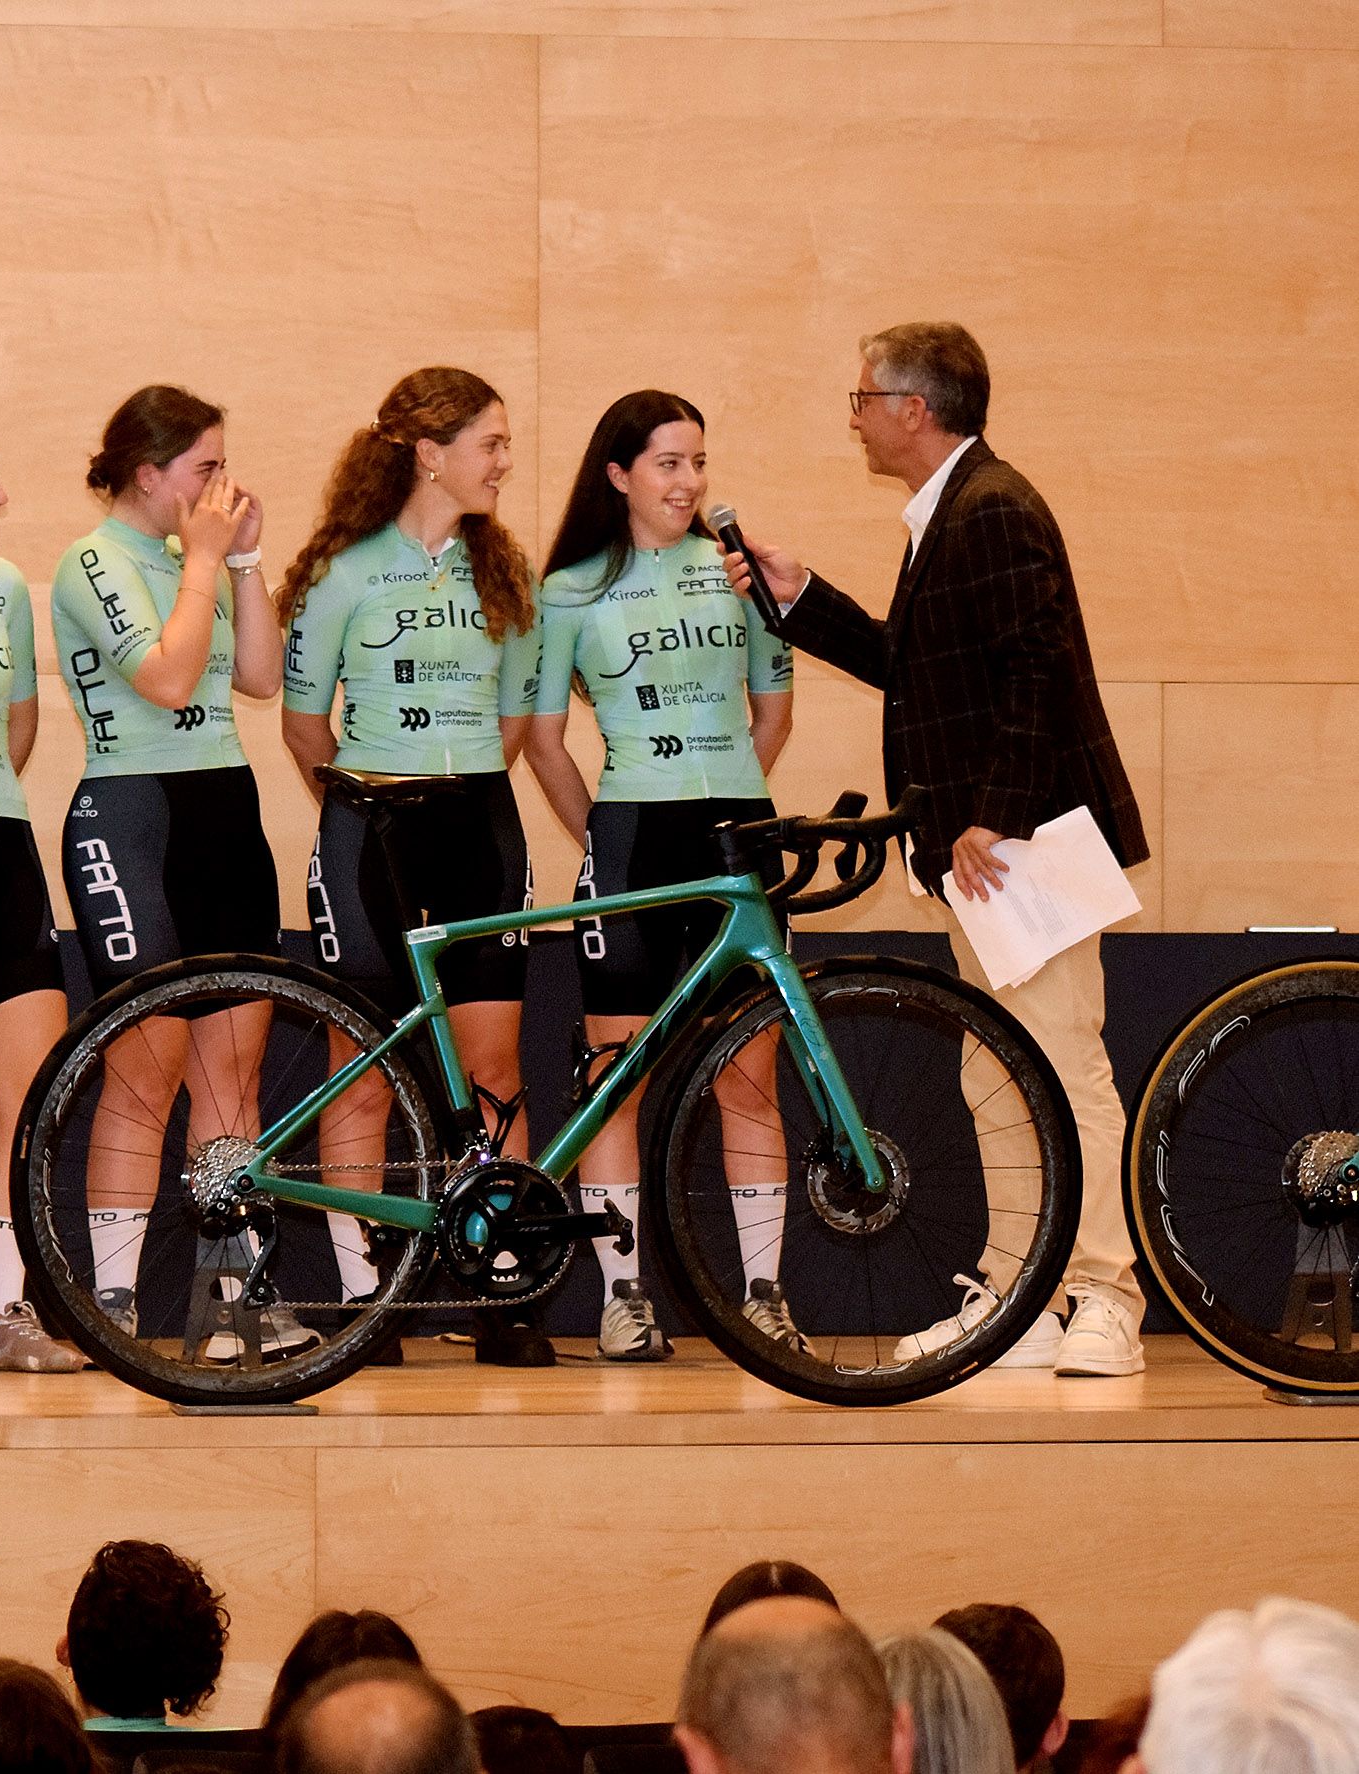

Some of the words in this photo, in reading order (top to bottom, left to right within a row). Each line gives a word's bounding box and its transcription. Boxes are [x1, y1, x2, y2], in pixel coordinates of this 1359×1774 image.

[381, 571, 430, 584] Kiroot
[80, 548, 134, 636] FARTO
[608, 588, 658, 602] Kiroot
[111, 626, 152, 659] SKODA
[598, 618, 747, 679] galicia
[418, 660, 460, 671] XUNTA
[418, 672, 434, 682] DE
[437, 672, 482, 682] GALICIA
[661, 682, 703, 693] XUNTA
[71, 647, 119, 755] FARTO
[663, 695, 680, 706] DE
[683, 692, 727, 704] GALICIA
[76, 838, 137, 962] FARTO
